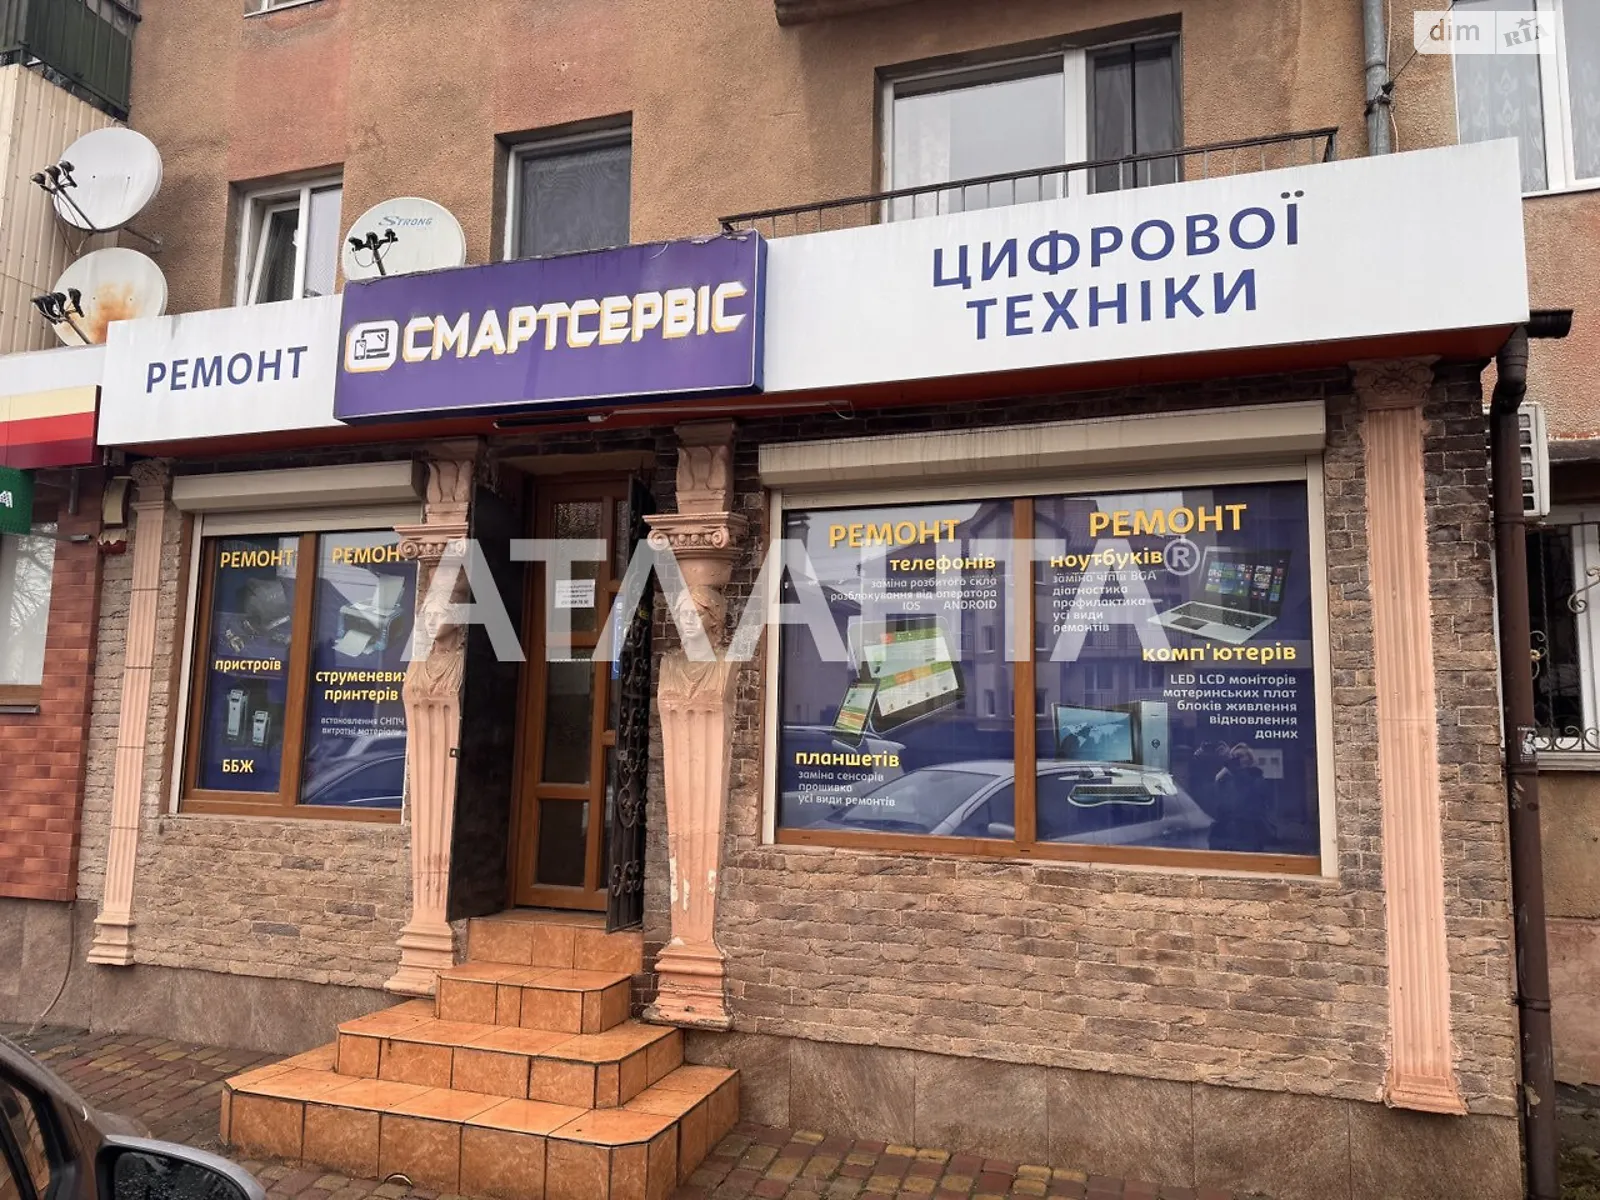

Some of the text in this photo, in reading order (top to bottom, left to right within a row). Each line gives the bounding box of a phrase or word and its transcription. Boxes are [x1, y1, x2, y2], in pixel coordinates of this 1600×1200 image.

[932, 190, 1304, 290] ЦИФРОВОЇ
[966, 268, 1257, 340] ТЕХНІКИ
[402, 281, 748, 364] СМАРТСЕРВІС
[146, 345, 309, 394] РЕМОНТ
[1088, 503, 1248, 538] РЕМОНТ
[828, 518, 962, 549] РЕМОНТ
[219, 549, 295, 568] РЕМОНТ
[331, 545, 406, 564] РЕМОН
[1049, 547, 1164, 572] ноутбуків
[889, 553, 997, 575] телефонів
[871, 578, 907, 588] заміна
[969, 576, 997, 587] скла
[1053, 572, 1093, 584] заміна
[1130, 570, 1157, 581] BGA
[935, 588, 997, 600] оператора
[1052, 585, 1129, 596] діагностика
[902, 599, 998, 611] IOS ANDROID
[1052, 609, 1105, 621] усі види
[1052, 621, 1111, 634] ремонтів
[214, 657, 282, 673] пристроїв
[1170, 673, 1297, 688] LED LCD моніторів
[324, 686, 399, 705] принтерів
[1163, 687, 1297, 701] материнських плат
[1177, 701, 1297, 713] блоків живлення
[1209, 713, 1298, 727] відновлення
[1255, 728, 1299, 740] даних
[221, 758, 255, 774] ББЖ
[794, 750, 901, 768] планшетів
[798, 769, 885, 782] заміна сенсорів
[798, 782, 852, 793] прошивка
[798, 793, 896, 807] усі види ремонтів
